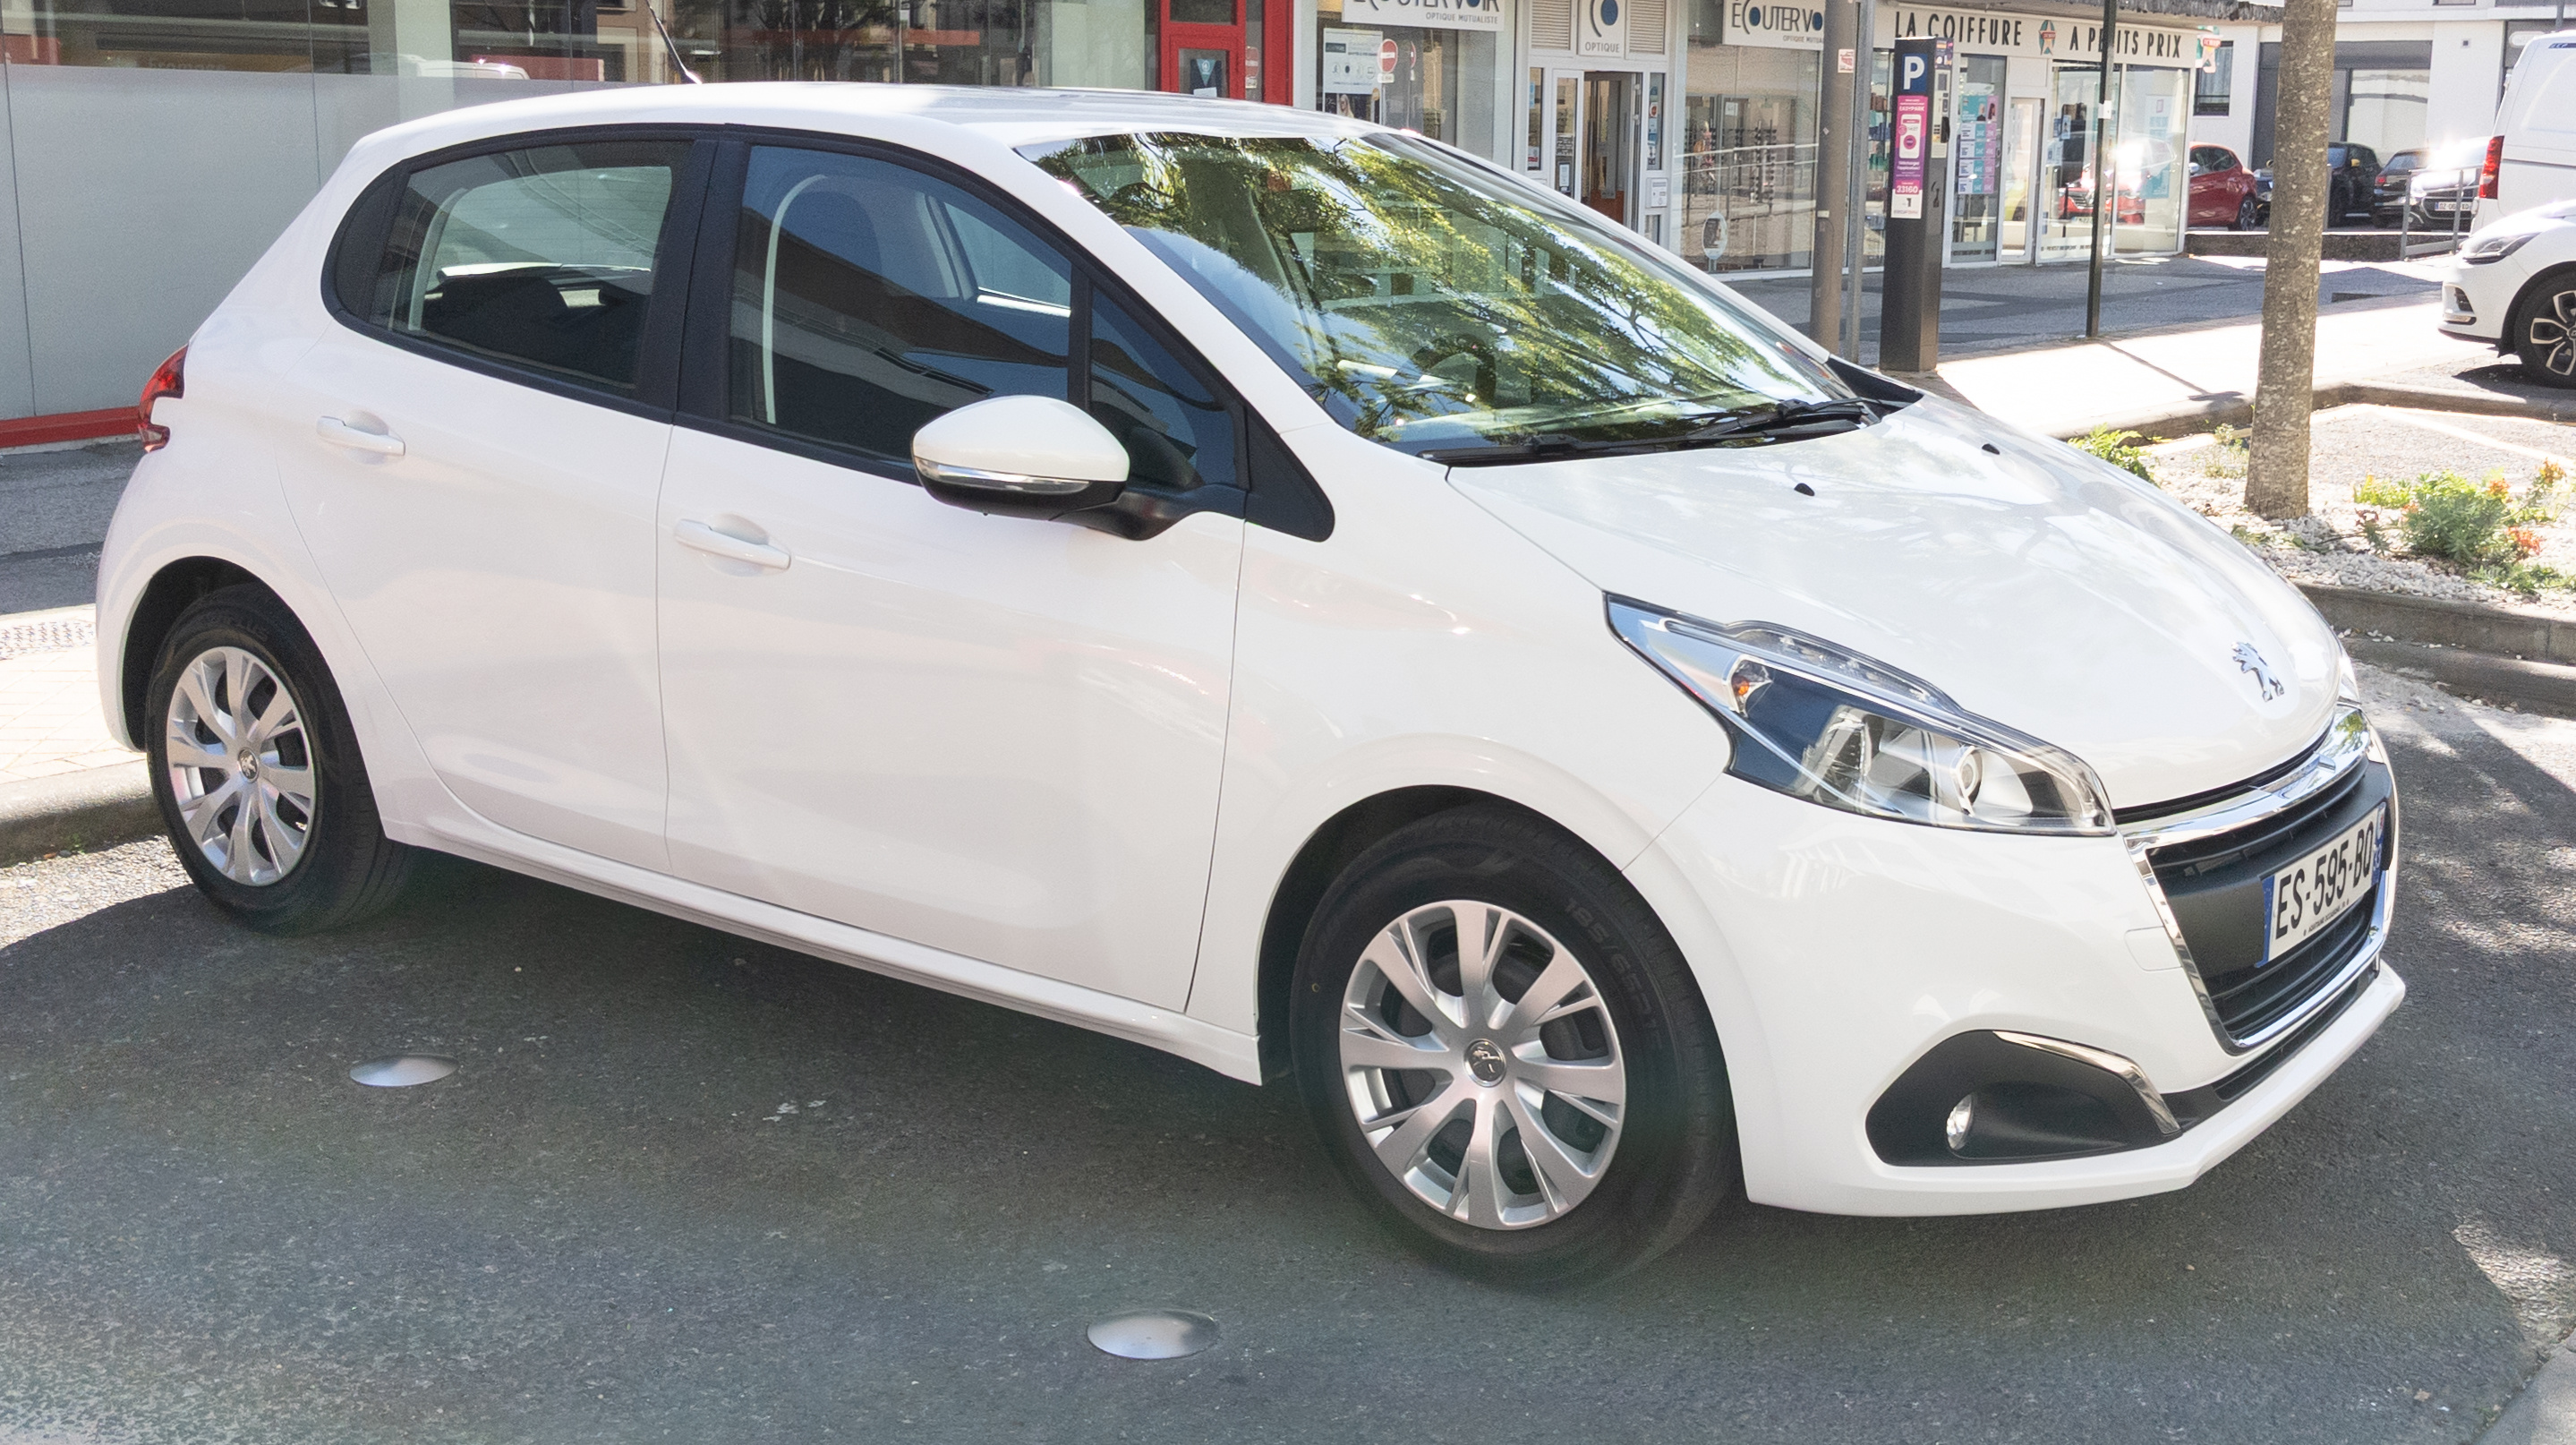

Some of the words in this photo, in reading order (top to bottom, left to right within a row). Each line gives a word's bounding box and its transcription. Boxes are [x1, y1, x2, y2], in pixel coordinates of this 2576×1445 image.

[1426, 12, 1455, 21] OPTIQUE
[1457, 13, 1498, 24] MUTUALISTE
[1803, 9, 1823, 32] VO
[1895, 11, 1916, 38] LA
[1928, 13, 2022, 46] COIFFURE
[1584, 41, 1620, 53] OPTIQUE
[2069, 26, 2079, 51] A
[2087, 28, 2139, 55] PEITS
[2146, 32, 2182, 58] PRIX
[1903, 56, 1925, 90] P
[2275, 821, 2374, 940] ES-595-BQ
